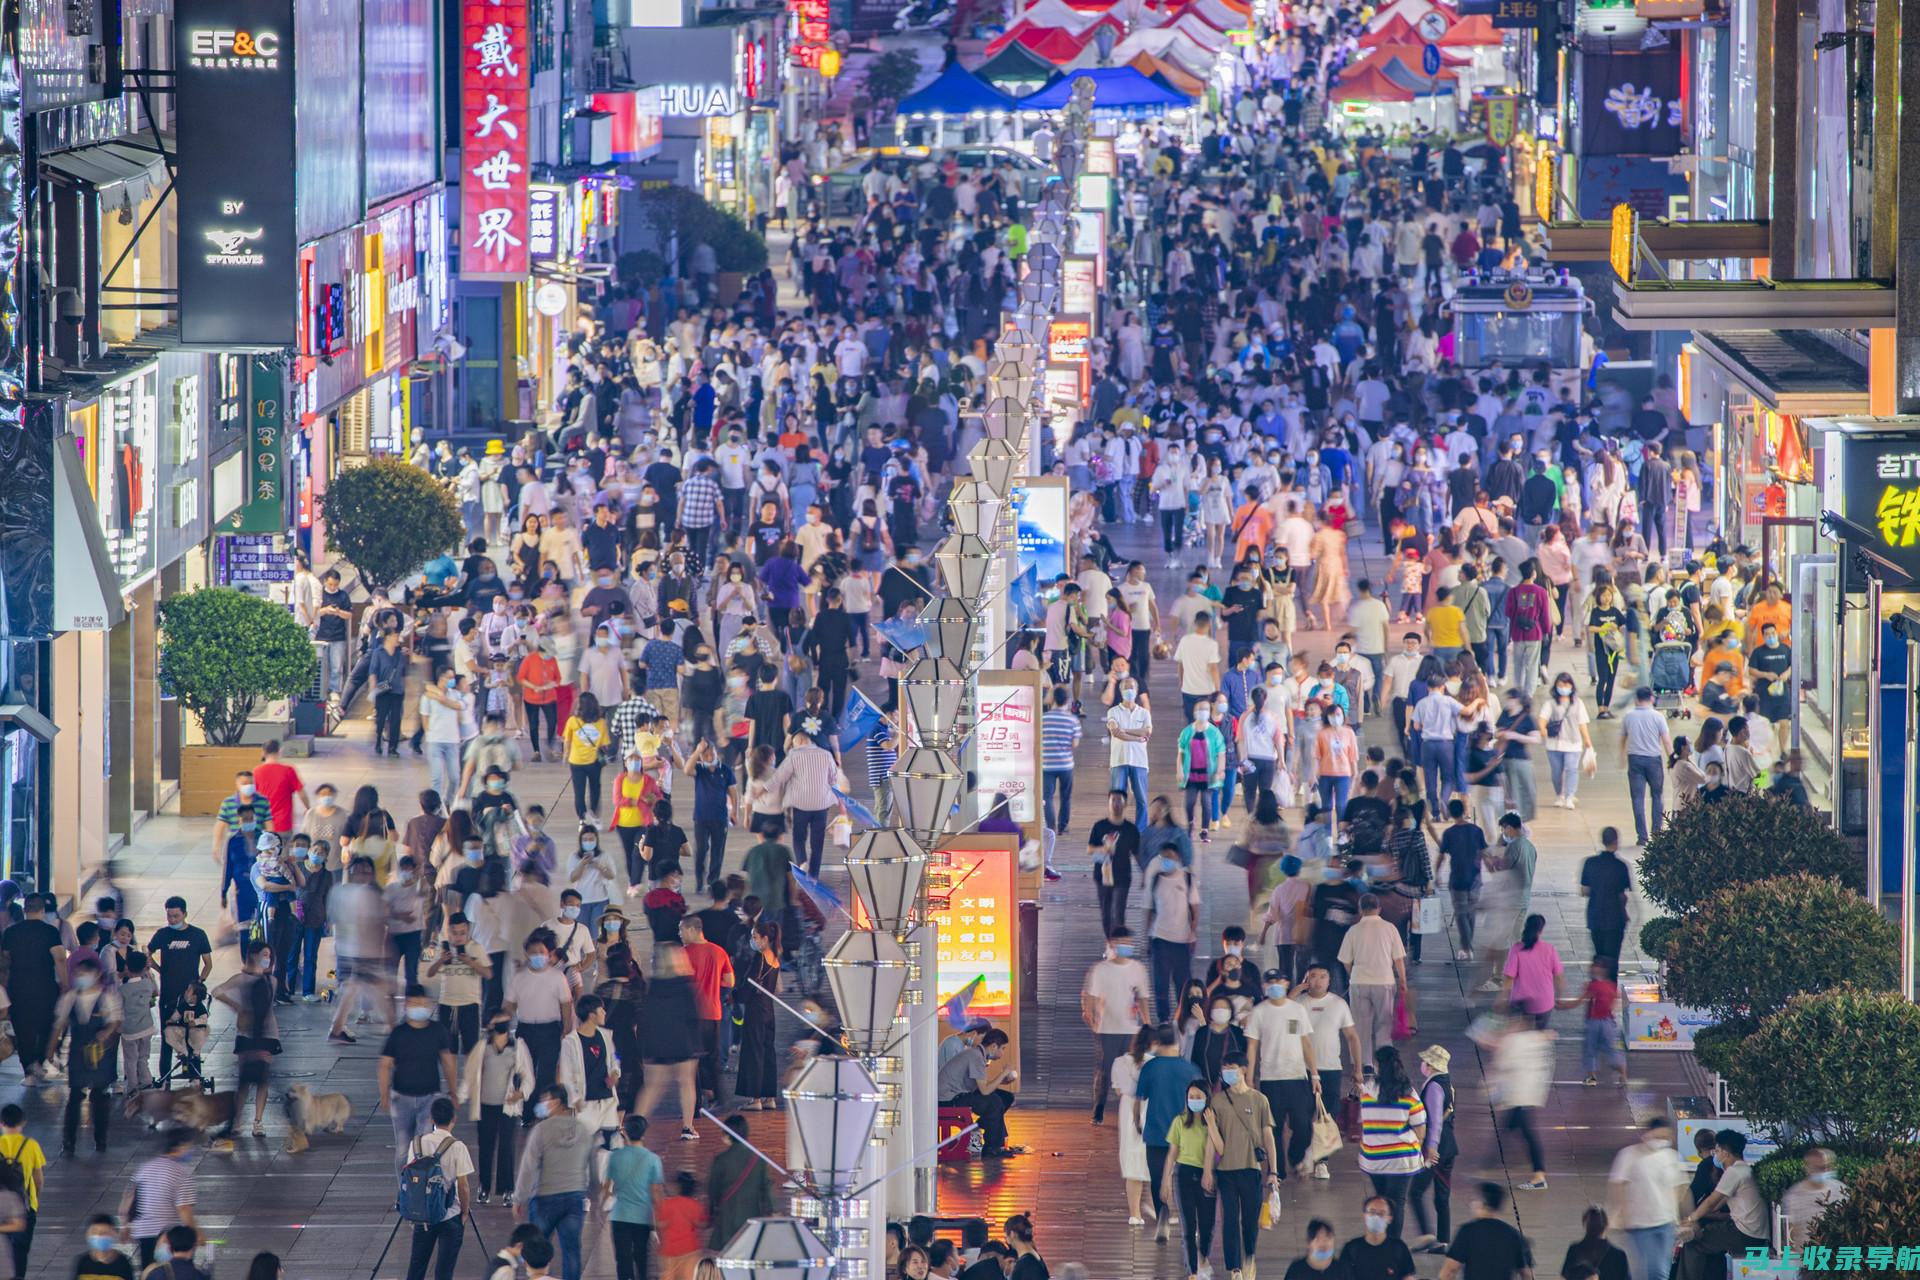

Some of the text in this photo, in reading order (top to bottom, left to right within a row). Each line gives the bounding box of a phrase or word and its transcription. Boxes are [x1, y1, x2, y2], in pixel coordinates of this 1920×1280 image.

[192, 31, 279, 55] EF&C
[660, 85, 736, 116] HUA
[473, 0, 522, 263] 戴大世界
[224, 201, 244, 214] BY
[206, 255, 264, 264] SEPTWOLVES
